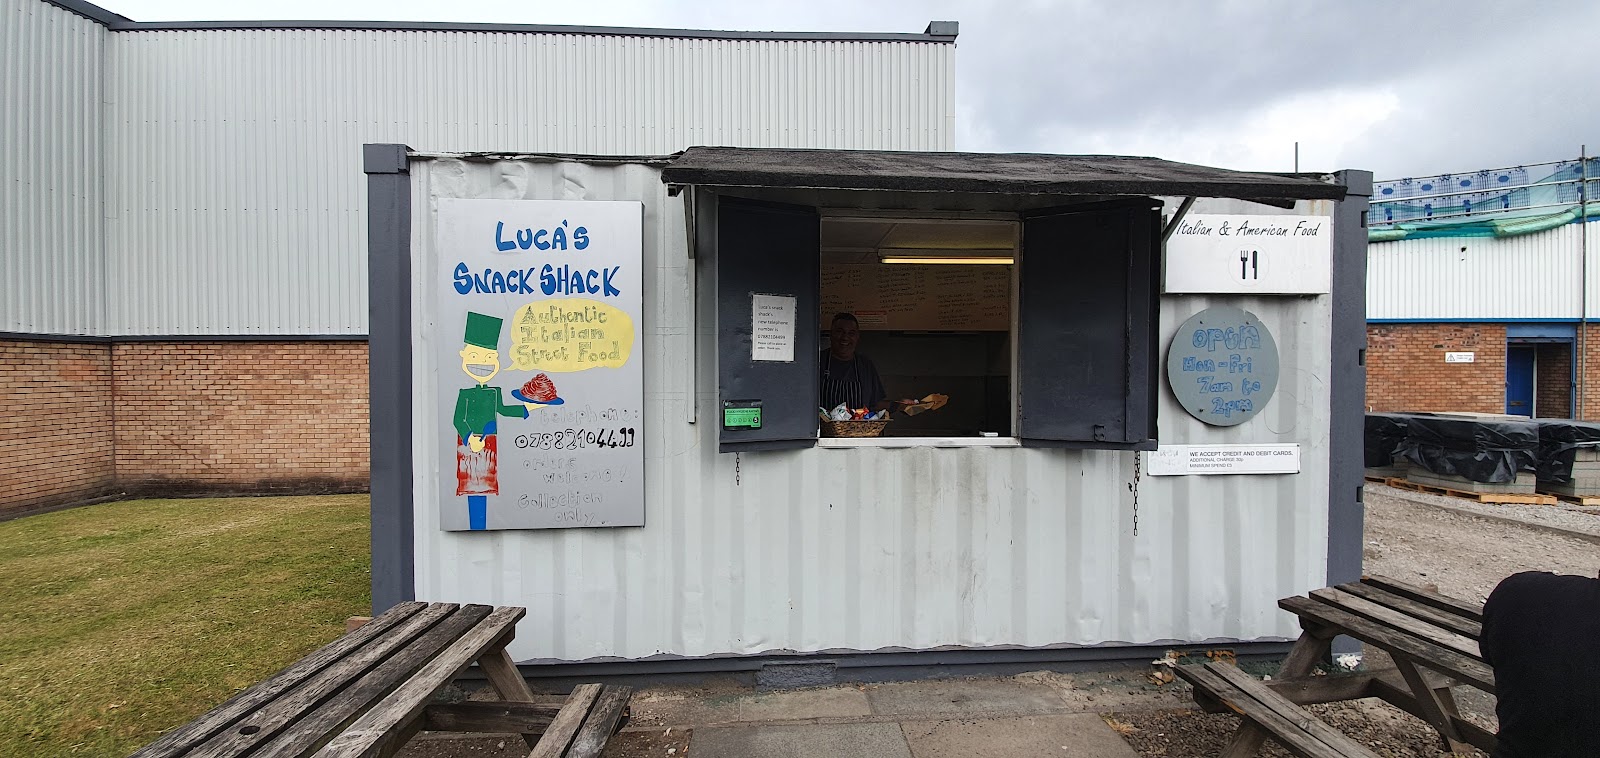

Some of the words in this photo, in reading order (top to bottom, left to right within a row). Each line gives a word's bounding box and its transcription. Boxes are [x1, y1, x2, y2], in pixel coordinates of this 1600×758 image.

[495, 220, 590, 251] LUCA'S
[1176, 219, 1213, 235] Italian
[1219, 220, 1232, 236] &
[1236, 219, 1288, 237] American
[1293, 220, 1322, 237] Food
[453, 261, 535, 296] SNACK
[539, 263, 621, 297] SHACK
[519, 304, 608, 325] Authentic
[520, 322, 605, 344] Italian
[516, 344, 570, 366] Street
[577, 340, 621, 362] Food
[1197, 376, 1233, 394] 7am
[1241, 377, 1261, 396] to
[1211, 397, 1253, 418] 2pm
[514, 427, 635, 450] 07882104499
